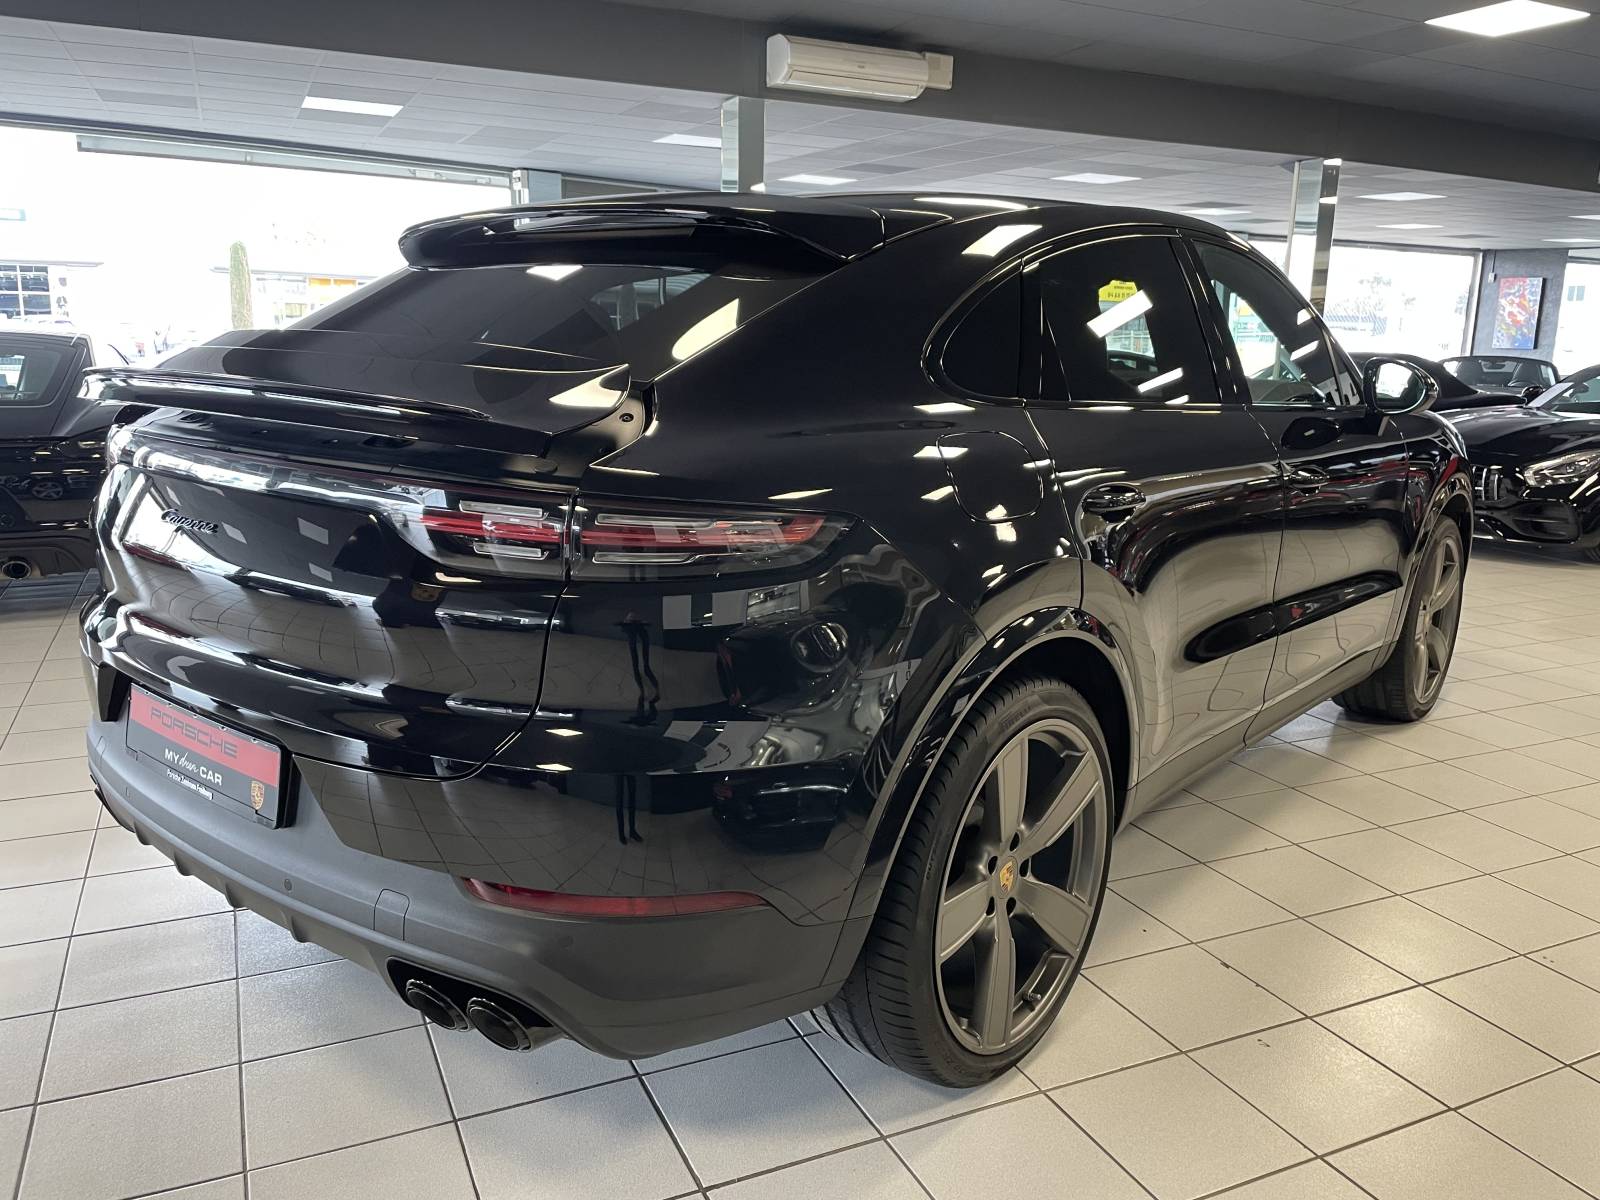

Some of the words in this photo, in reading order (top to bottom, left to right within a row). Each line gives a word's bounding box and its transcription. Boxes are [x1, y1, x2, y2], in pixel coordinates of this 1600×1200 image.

[161, 508, 219, 534] Cayenne
[150, 706, 238, 759] PORSCHE
[164, 748, 179, 764] MY
[199, 766, 223, 786] CAR
